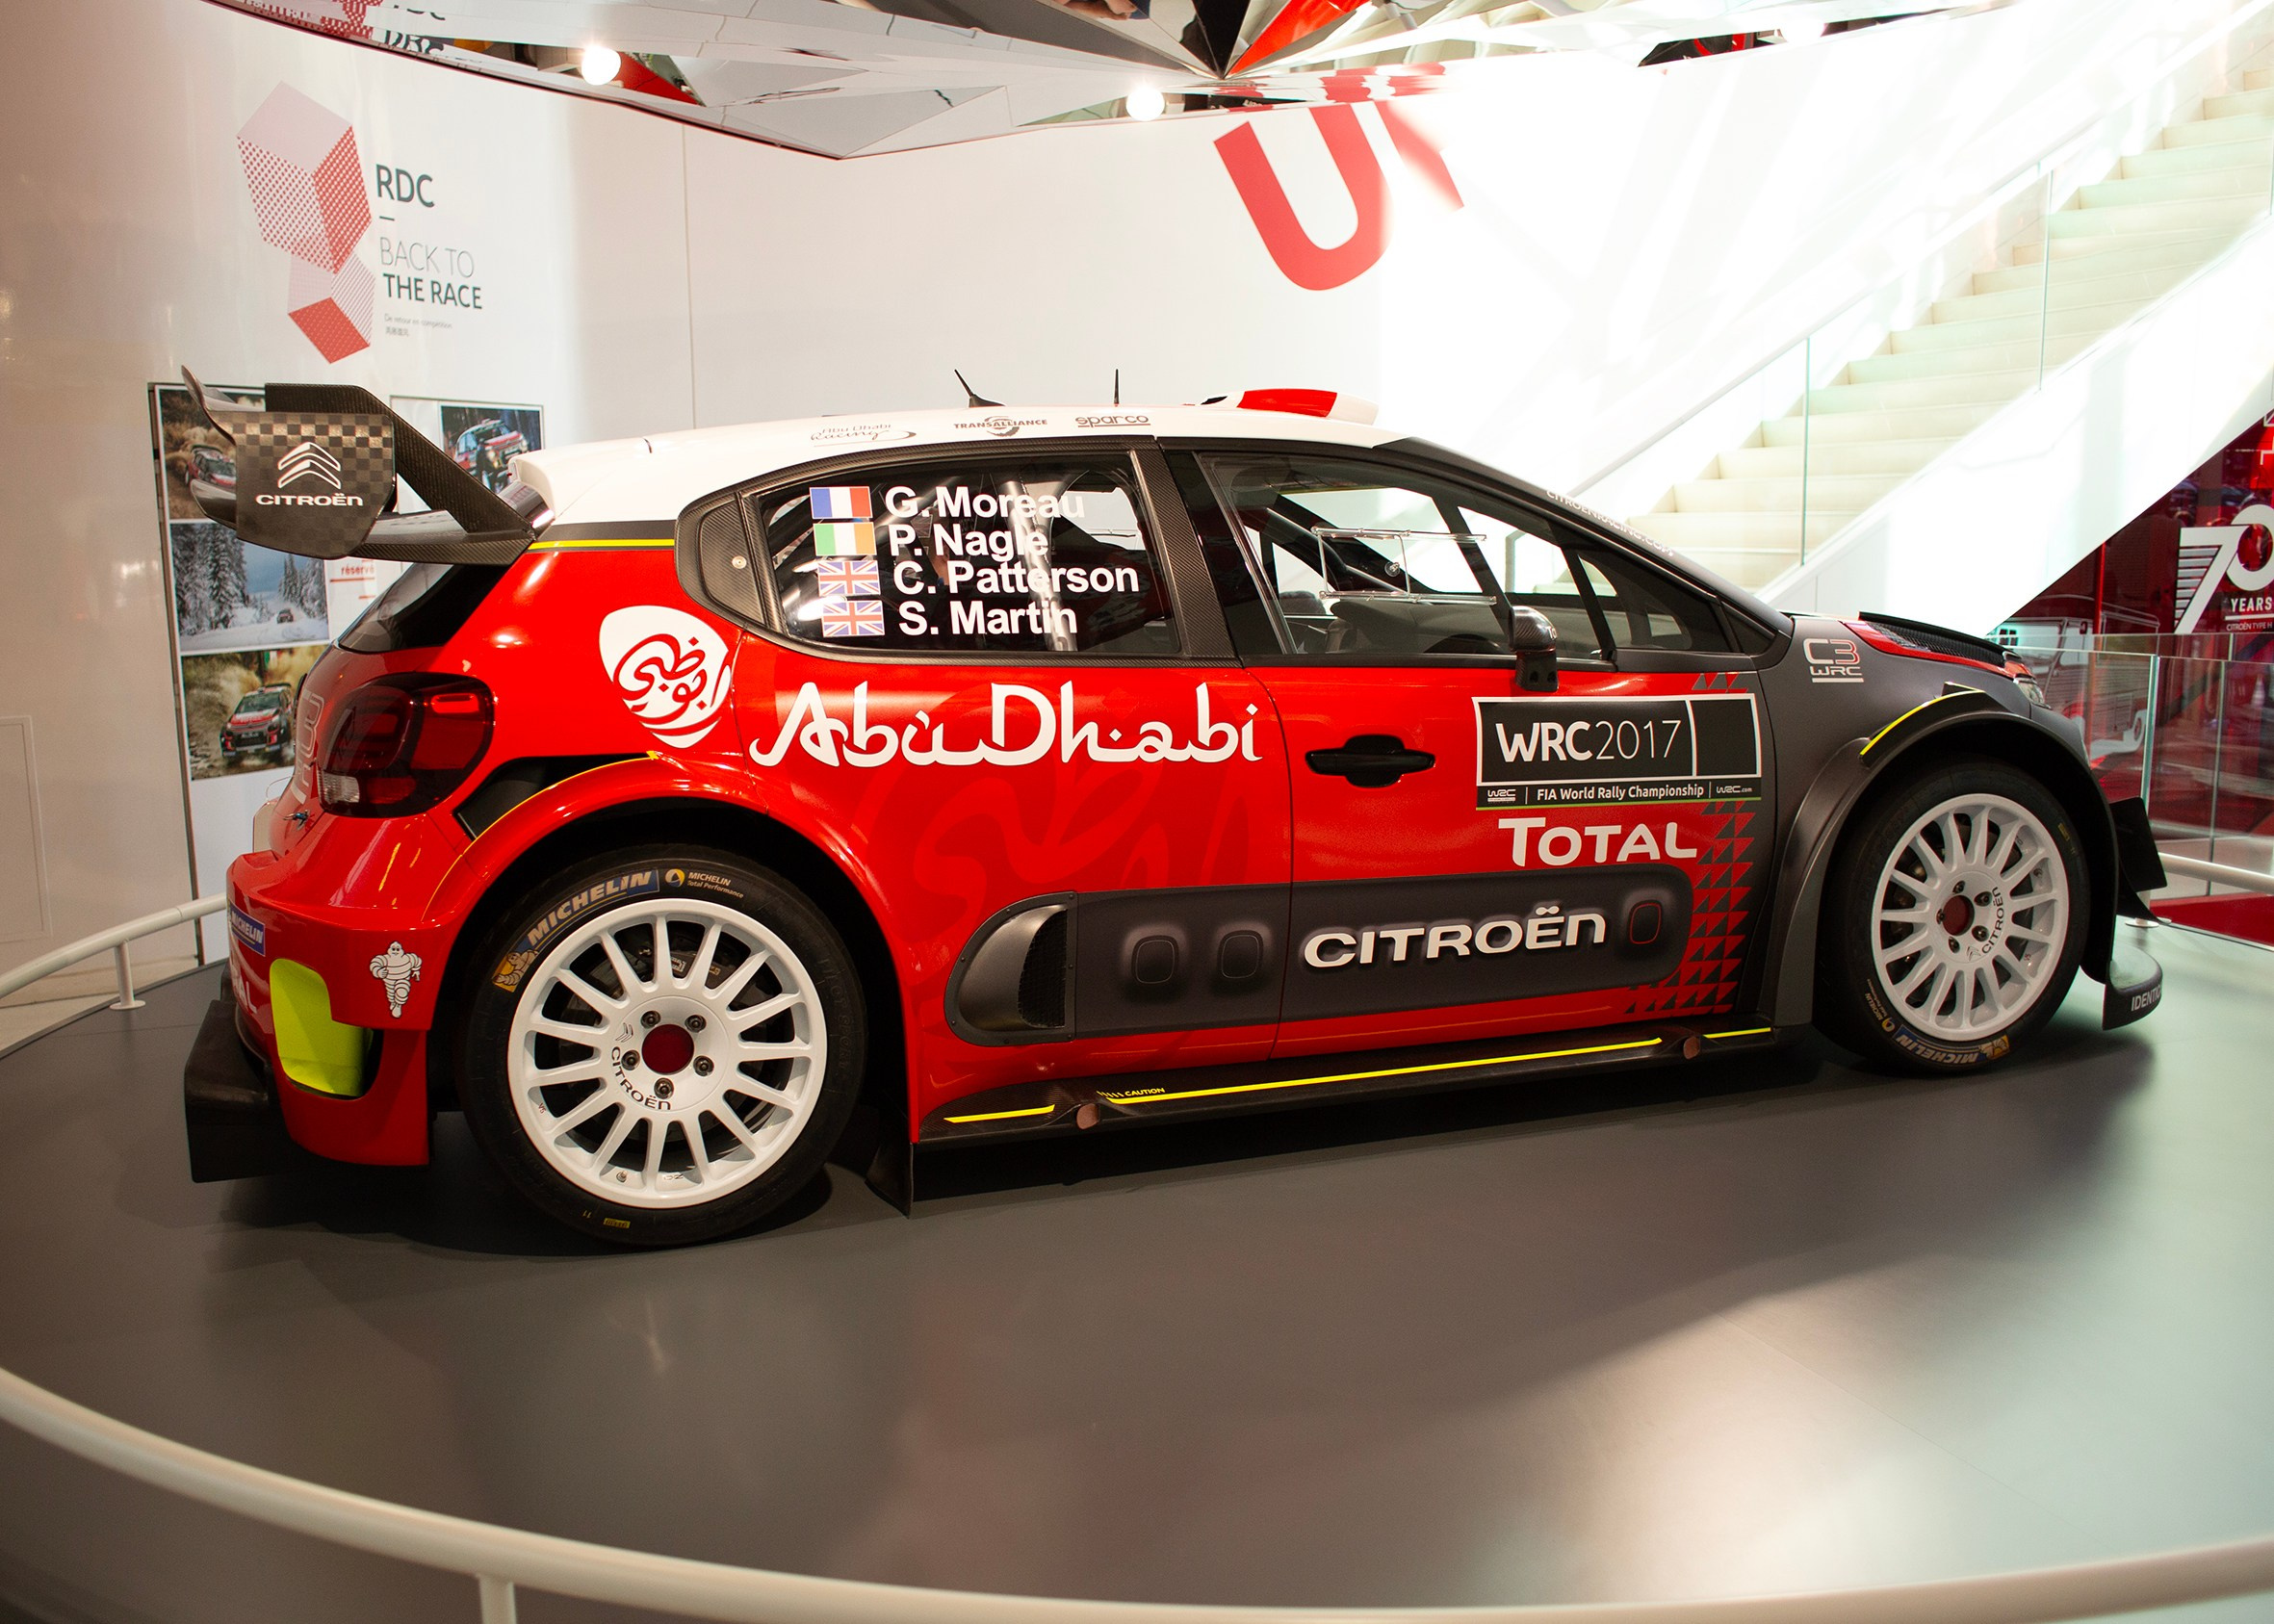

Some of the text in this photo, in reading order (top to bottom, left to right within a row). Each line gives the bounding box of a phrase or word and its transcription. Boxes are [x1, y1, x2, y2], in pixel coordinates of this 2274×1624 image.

[376, 164, 435, 208] RDC
[380, 237, 474, 278] BACK TO
[383, 272, 482, 309] THE RACE
[954, 419, 1047, 429] TRANSALLIANCE
[1075, 415, 1149, 427] sparco
[256, 493, 363, 506] CITROËN
[885, 485, 1085, 518] G. Moreau
[889, 524, 1049, 562] P. Nagle
[893, 560, 1140, 596] C. Patterson
[898, 600, 1078, 636] S. Martin
[2230, 596, 2273, 612] YEARS
[1802, 637, 1861, 665] C3
[1810, 665, 1863, 677] WRC
[980, 680, 1263, 766] Dhabi
[1495, 719, 1682, 762] WRC2017
[1537, 784, 1704, 801] FIA World Rally Championship
[688, 871, 732, 887] MICHELIN
[704, 882, 744, 898] Performance
[527, 870, 652, 947] MICHELIN
[1981, 887, 2004, 954] CITROËN
[230, 911, 264, 944] MICHELIN
[1304, 905, 1606, 967] CITROËN
[1896, 1034, 1979, 1064] MICHELIN
[611, 1045, 671, 1111] CITROËN
[1124, 1087, 1166, 1096] CAUTION
